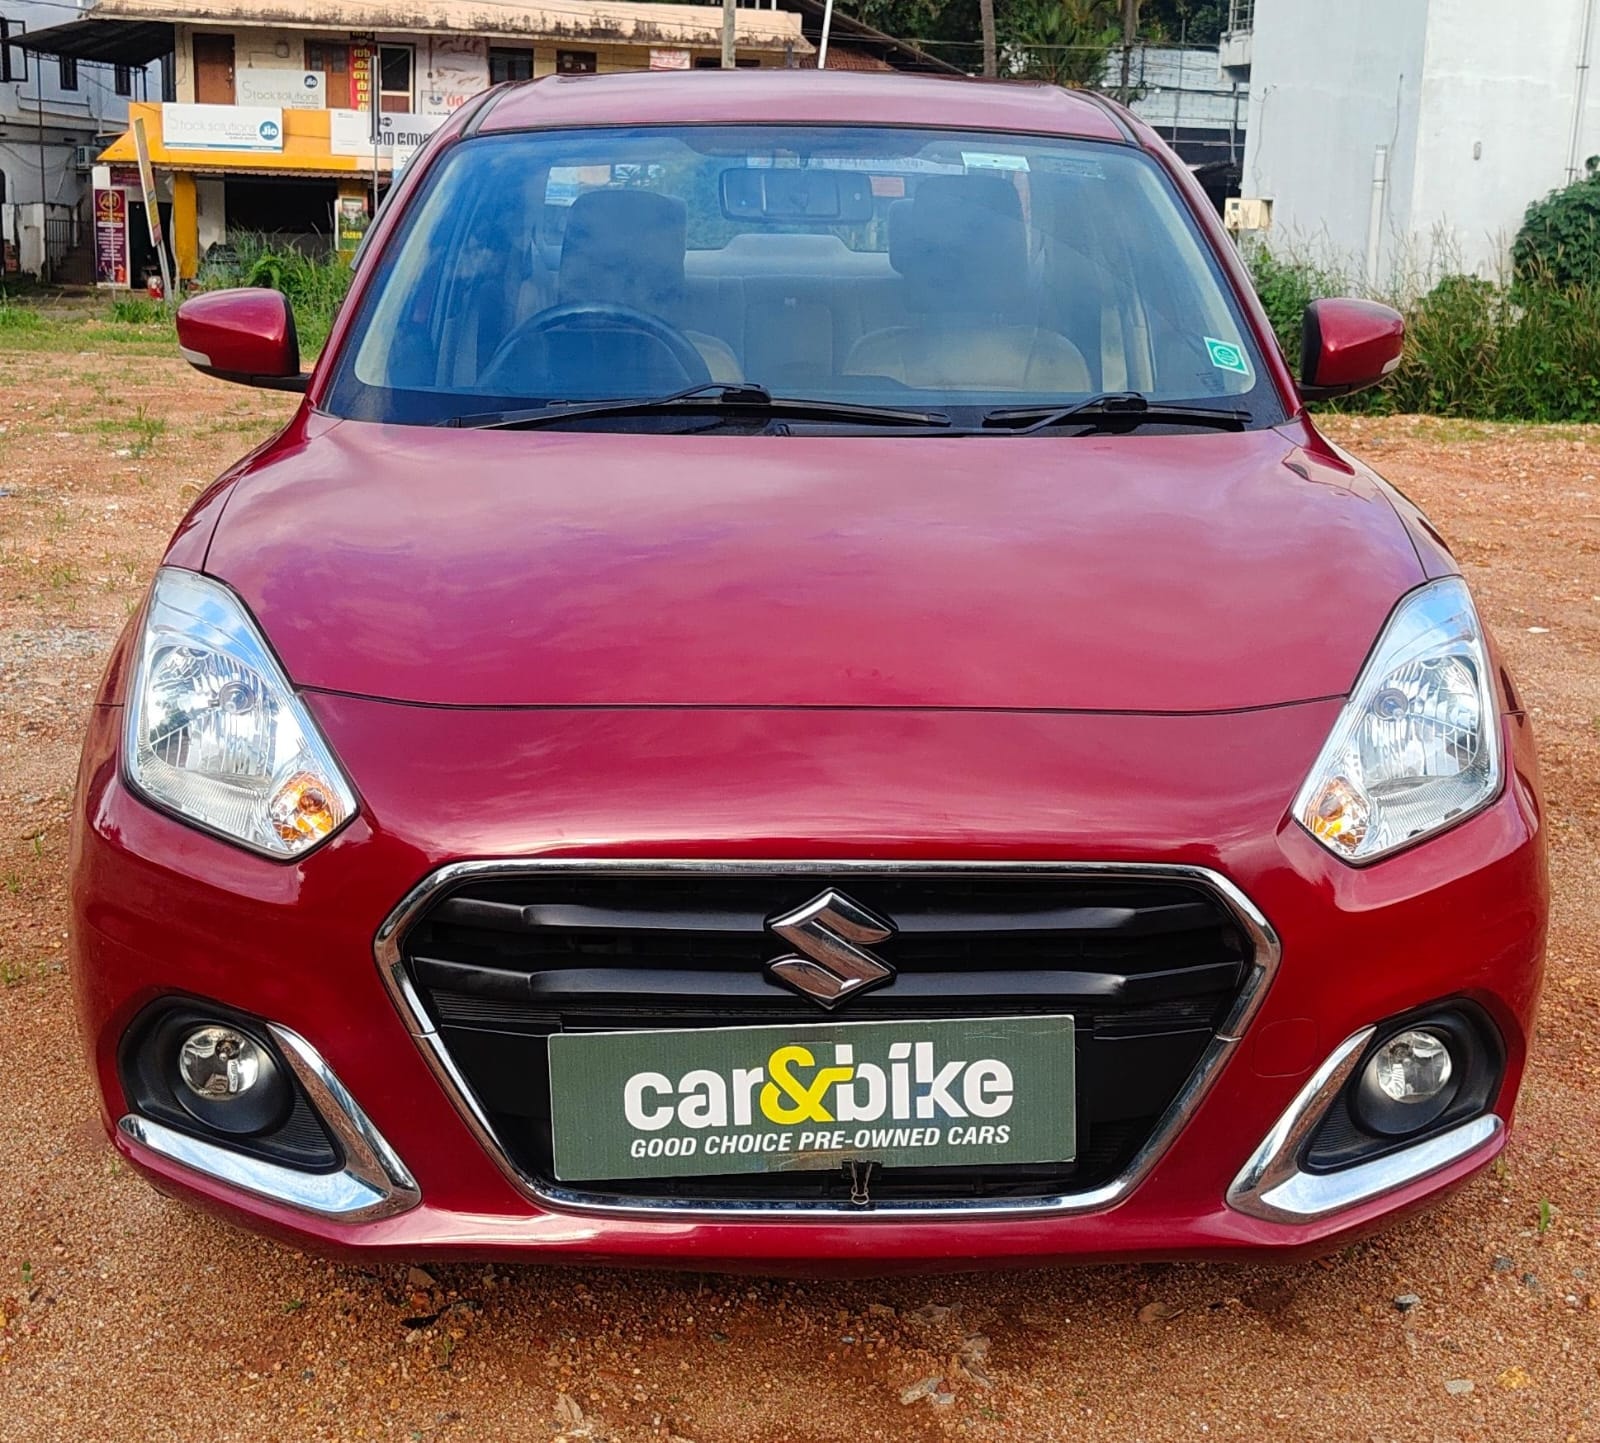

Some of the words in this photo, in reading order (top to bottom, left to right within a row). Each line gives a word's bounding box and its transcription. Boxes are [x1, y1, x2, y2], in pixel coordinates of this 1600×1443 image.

[262, 124, 278, 137] Jio
[624, 1041, 1014, 1131] car&bike
[630, 1137, 697, 1158] GOOD
[704, 1132, 793, 1154] CHOICE
[798, 1127, 941, 1151] PRE-OWNED
[947, 1125, 1011, 1145] CARS
